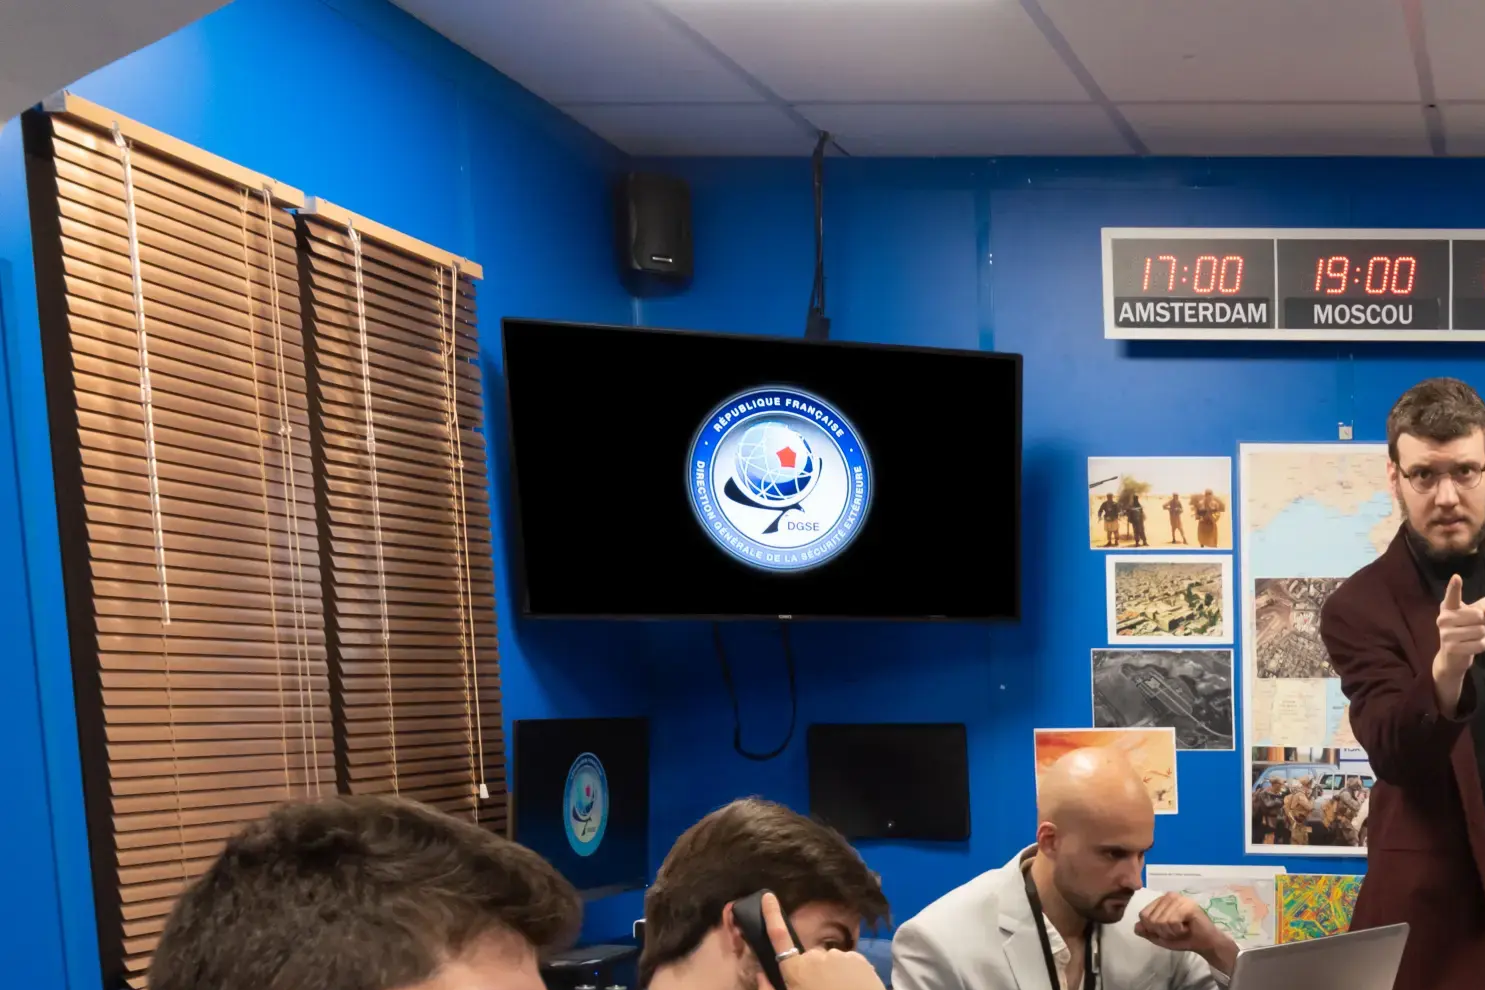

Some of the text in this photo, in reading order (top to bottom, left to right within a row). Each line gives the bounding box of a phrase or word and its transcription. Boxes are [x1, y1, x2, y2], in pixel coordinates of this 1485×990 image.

[1142, 255, 1244, 294] 17:00
[1315, 256, 1416, 294] 19:00
[1118, 302, 1267, 323] AMSTERDAM
[1313, 304, 1413, 325] MOSCOU
[713, 397, 845, 438] RÉPUBLIQUE FRANÇAISE
[695, 460, 864, 562] DIRECTION GÉNÉRALE DE LA SÉCURITÉ EXTÉRIEURE
[787, 521, 820, 531] DGSE
